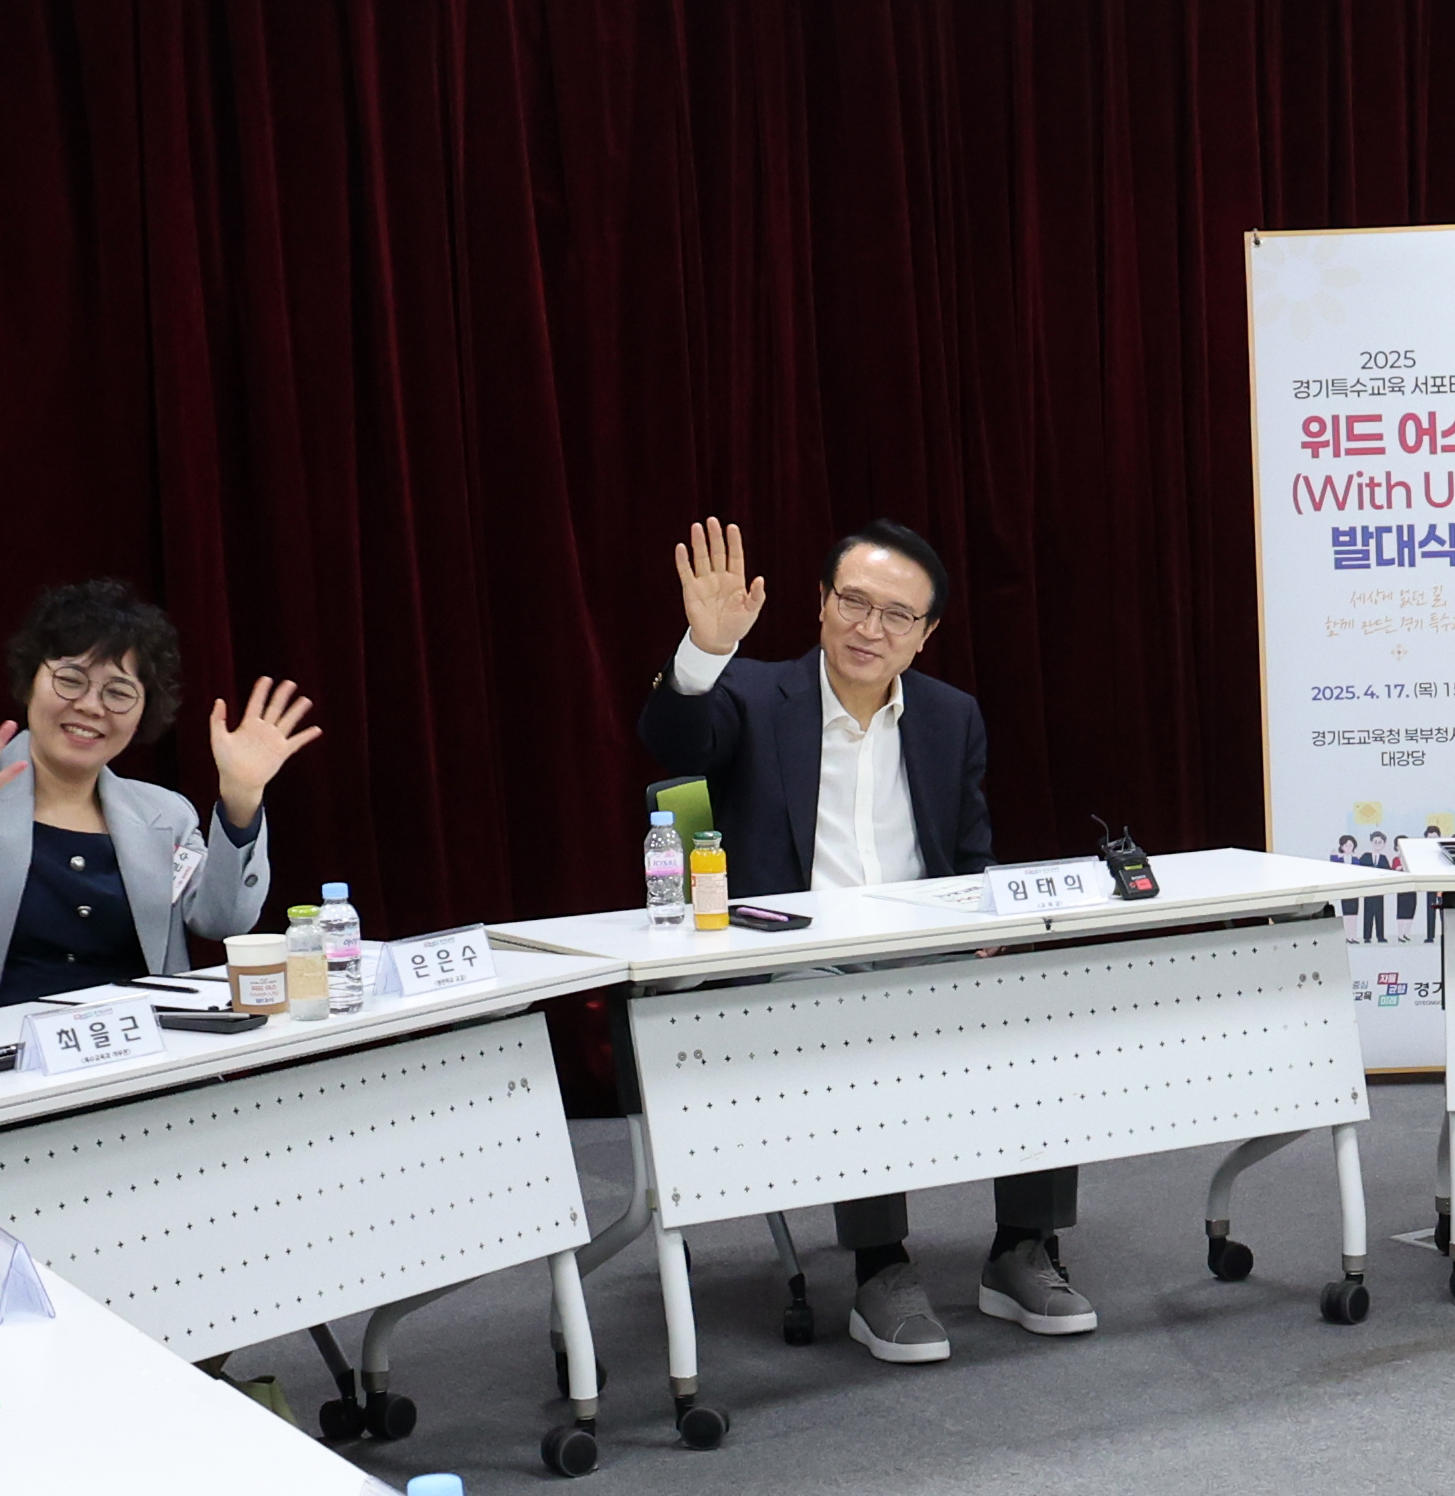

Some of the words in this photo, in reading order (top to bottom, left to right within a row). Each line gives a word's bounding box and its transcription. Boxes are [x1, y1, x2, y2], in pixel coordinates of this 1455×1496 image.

[1360, 350, 1417, 370] 2025
[1292, 376, 1406, 399] 경기특수교육
[1300, 413, 1387, 459] 위드
[1292, 470, 1413, 515] (With
[1350, 589, 1393, 608] 세상에
[1324, 615, 1355, 637] 함께
[1361, 615, 1398, 635] 만드는
[1400, 616, 1423, 632] 경기
[1311, 685, 1360, 701] 2025.
[1363, 684, 1380, 700] 4.
[1384, 683, 1410, 699] 17.
[1413, 682, 1438, 698] (목)
[1311, 728, 1401, 746] 경기도교육청
[1381, 750, 1426, 767] 대강당
[411, 945, 478, 978] 은은수
[56, 1015, 141, 1052] 최을근
